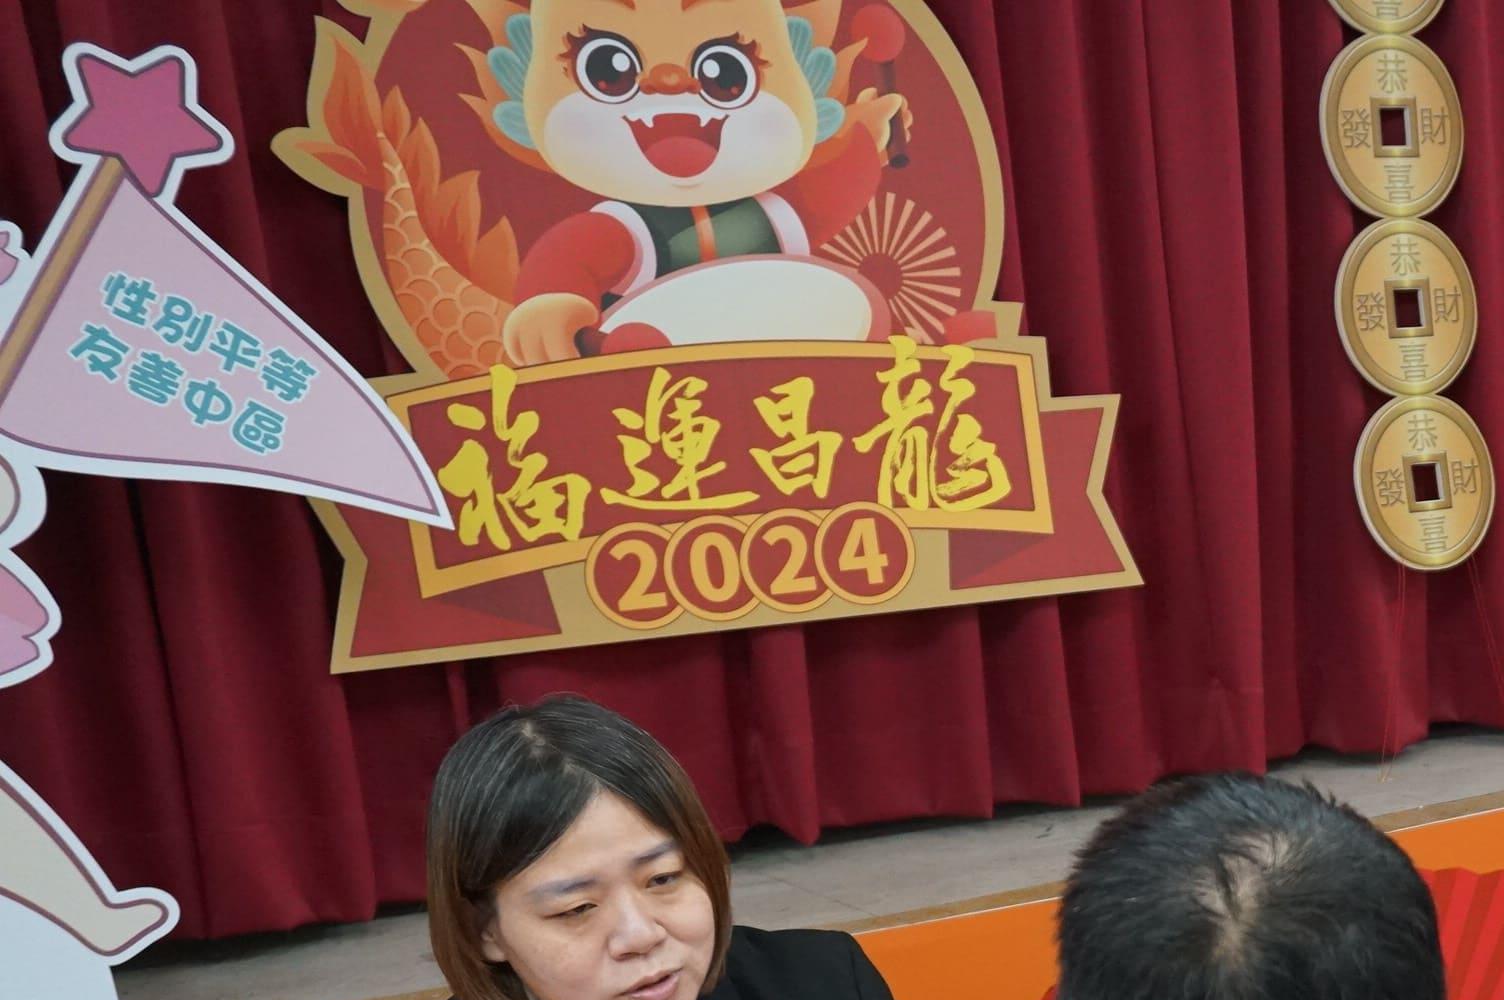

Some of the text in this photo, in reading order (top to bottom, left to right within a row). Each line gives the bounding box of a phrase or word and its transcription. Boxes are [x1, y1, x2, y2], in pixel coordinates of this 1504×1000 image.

[1342, 52, 1448, 202] 恭 喜 發 財
[104, 273, 318, 401] 性別平等
[1356, 237, 1461, 381] 恭 喜 發 財
[69, 323, 287, 453] 友善中區
[439, 335, 1011, 550] 福運昌龍
[1376, 415, 1479, 554] 恭 喜 發 財
[611, 518, 888, 613] 2024
